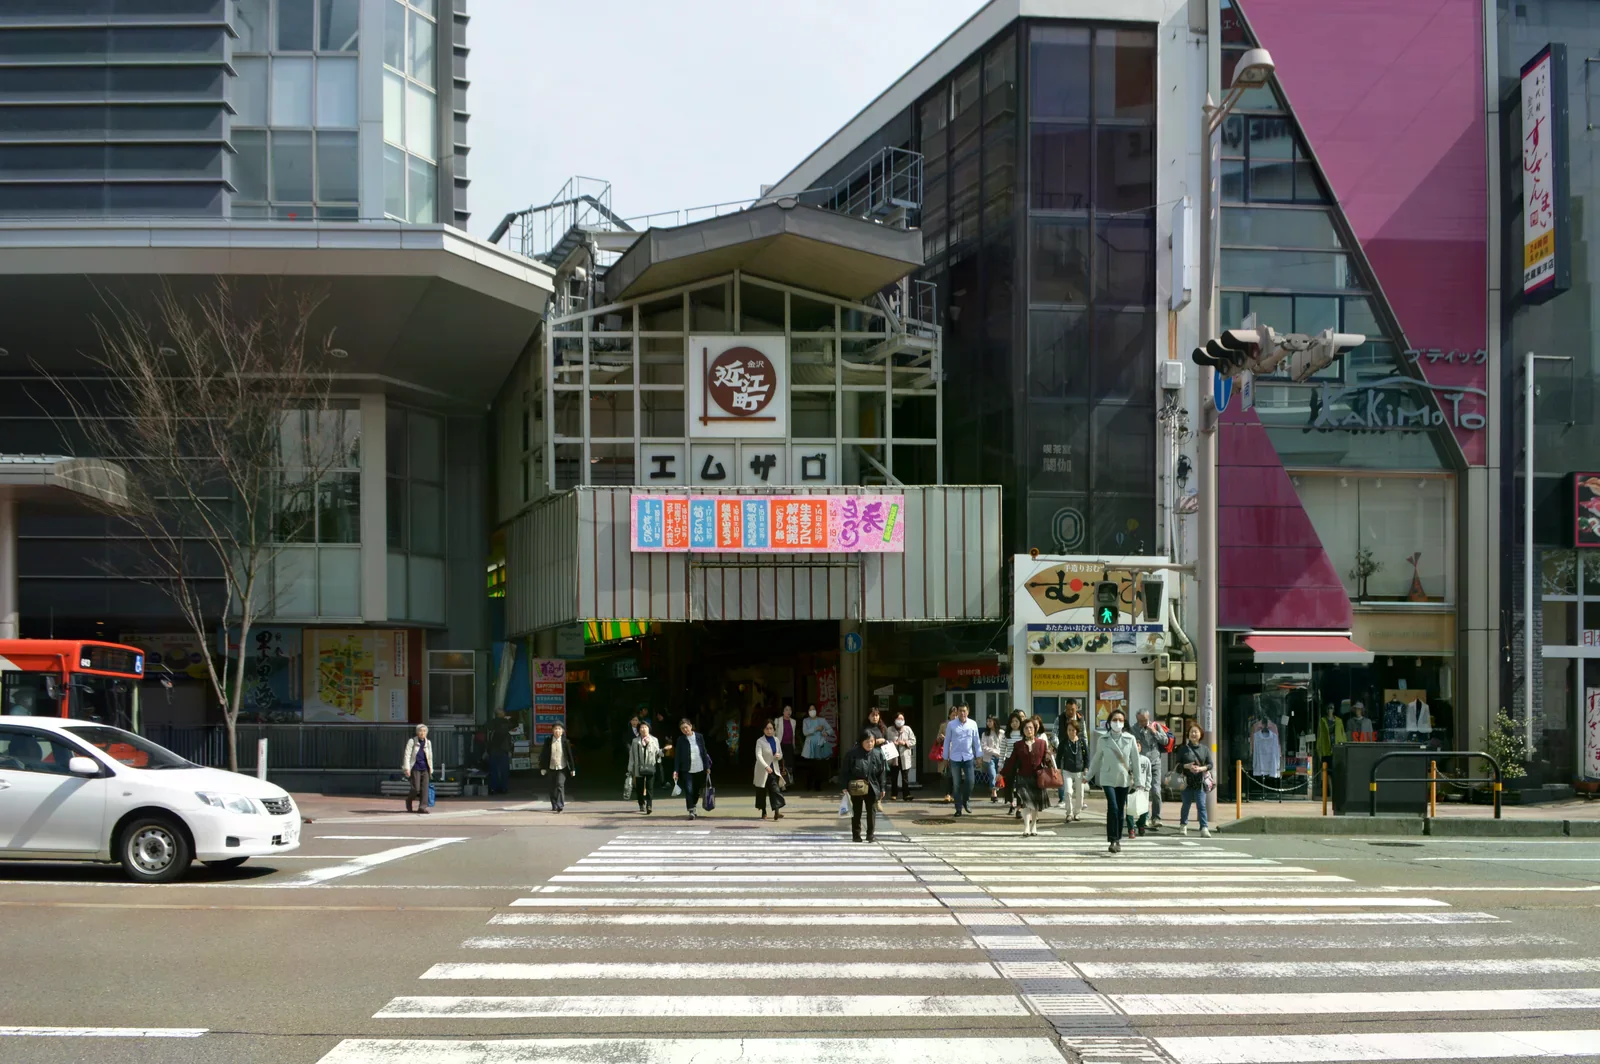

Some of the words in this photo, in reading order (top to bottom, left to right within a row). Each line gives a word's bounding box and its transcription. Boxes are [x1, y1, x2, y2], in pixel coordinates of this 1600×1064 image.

[747, 360, 765, 369] 金沢
[1403, 348, 1486, 364] ブティック
[713, 359, 770, 411] 近江町
[800, 503, 812, 544] 生本マグロ
